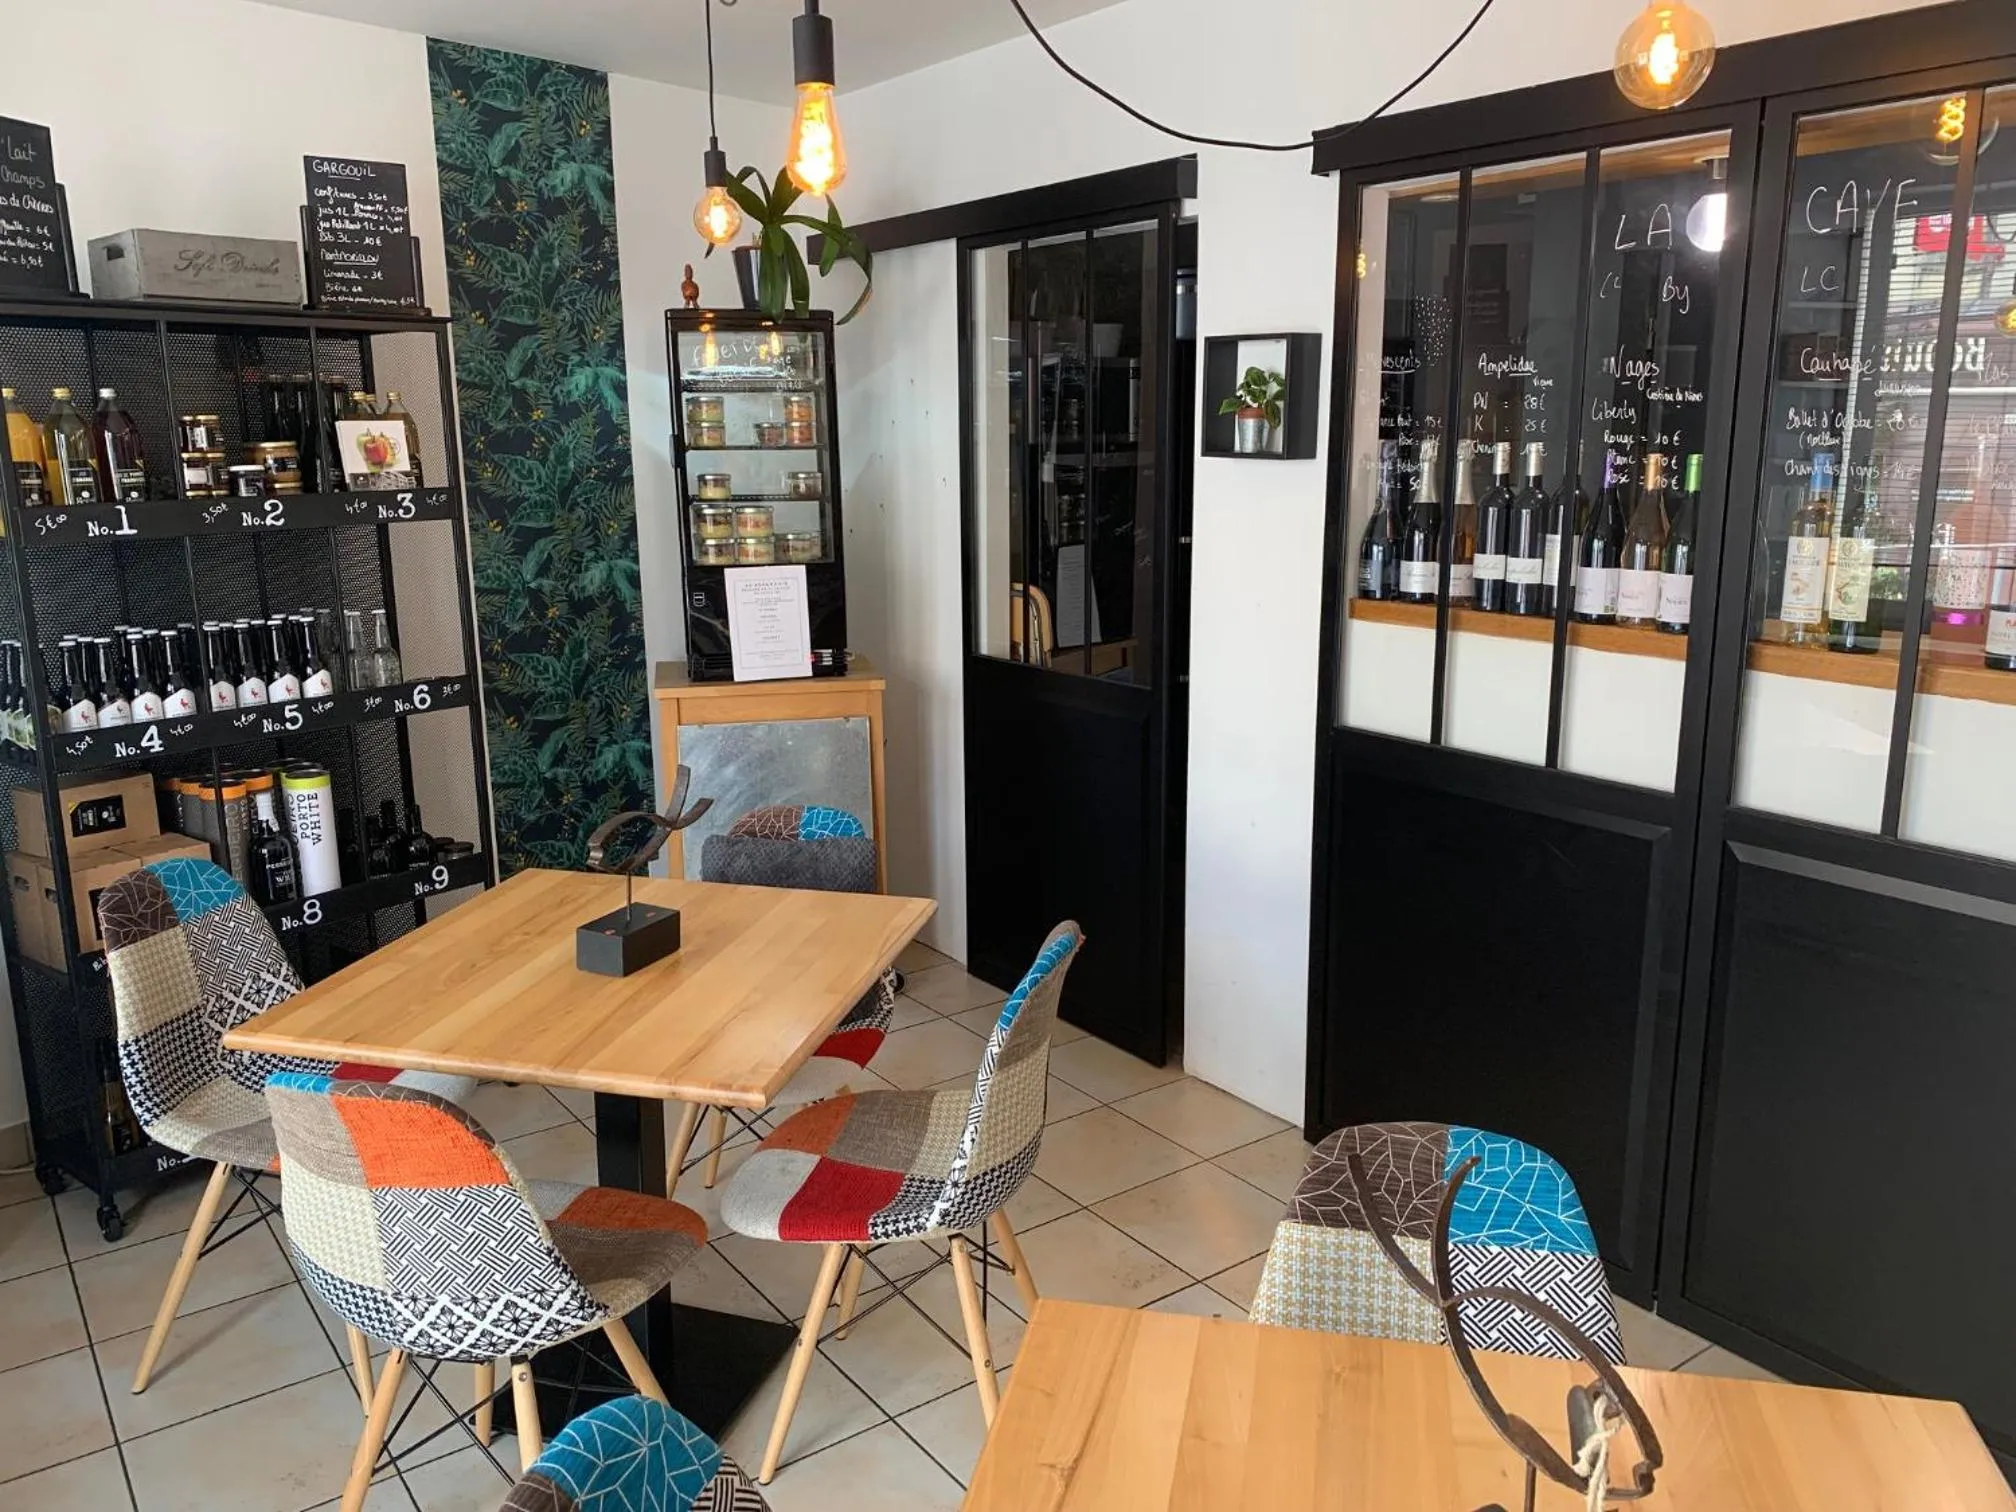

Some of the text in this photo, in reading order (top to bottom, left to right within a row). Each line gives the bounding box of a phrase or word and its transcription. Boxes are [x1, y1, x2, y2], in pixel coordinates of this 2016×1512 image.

[8, 136, 36, 162] Lait
[1614, 204, 1673, 250] LA
[1662, 276, 1690, 314] By
[1800, 266, 1839, 293] LC
[296, 793, 310, 840] PORTO
[306, 792, 323, 847] WHITE
